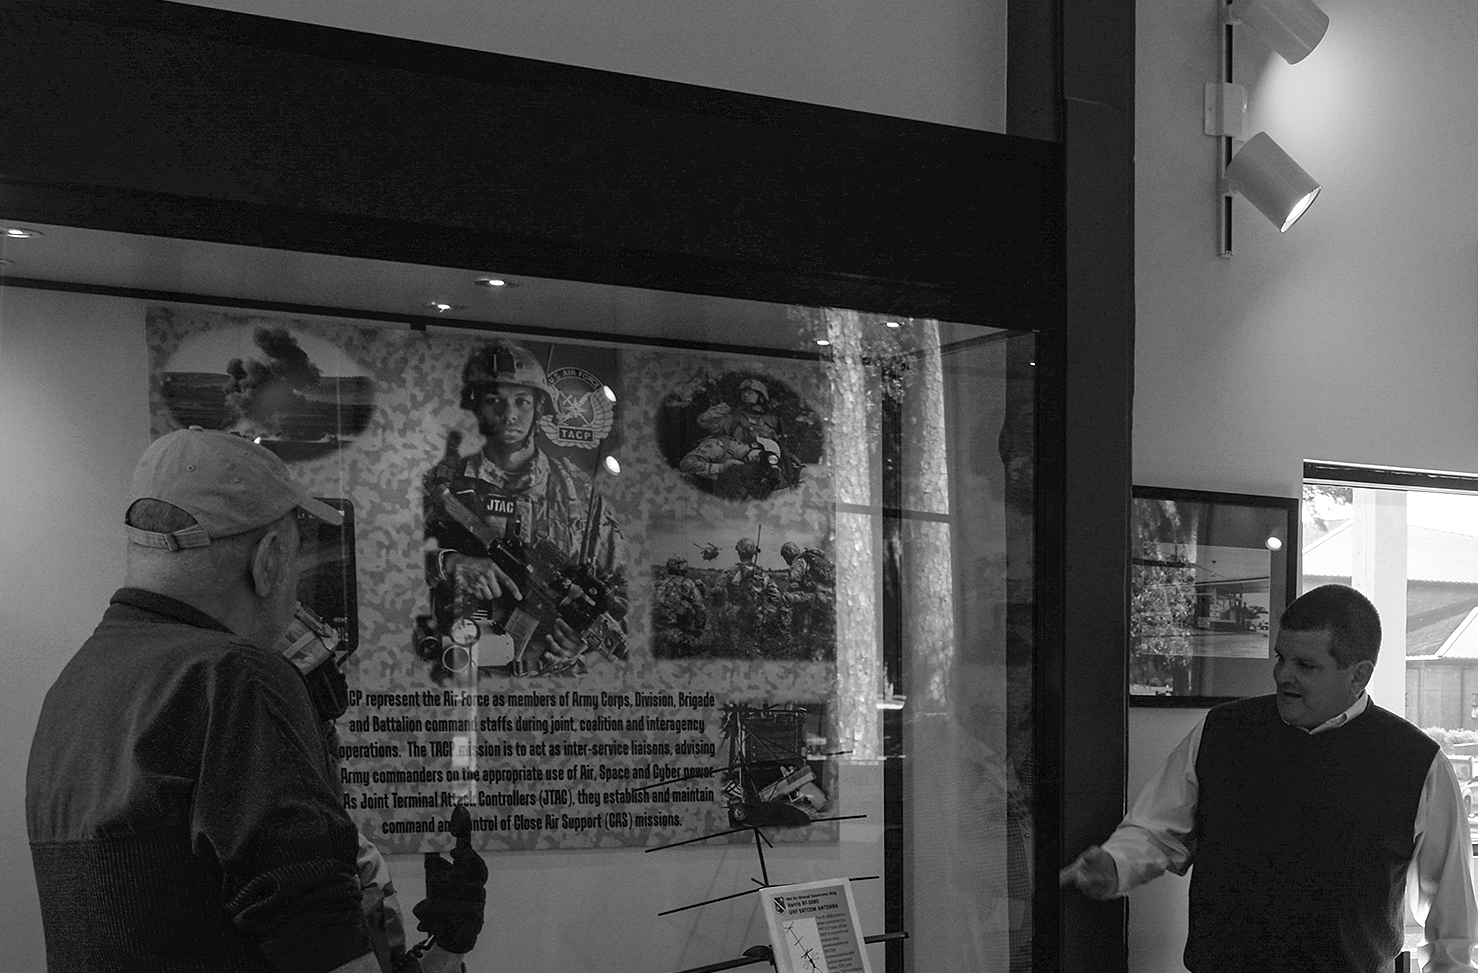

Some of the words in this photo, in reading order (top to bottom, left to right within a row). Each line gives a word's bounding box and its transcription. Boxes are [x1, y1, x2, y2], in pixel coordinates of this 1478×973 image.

[579, 371, 601, 389] FORCE
[561, 429, 591, 440] TACP
[487, 499, 514, 513] JTAC
[349, 691, 362, 707] CP
[366, 691, 420, 709] represent
[423, 691, 440, 707] the
[444, 691, 458, 706] Air
[461, 691, 489, 706] Force
[493, 694, 505, 707] as
[508, 691, 556, 707] members
[559, 691, 570, 707] of
[572, 691, 598, 709] Army
[601, 691, 633, 709] Corps,
[635, 692, 676, 708] Division,
[678, 692, 715, 709] Brigade
[350, 716, 369, 732] and
[373, 716, 422, 732] Battalion
[425, 716, 477, 732] command
[480, 716, 512, 732] staffs
[516, 716, 548, 734] during
[550, 716, 577, 734] joint,
[580, 716, 623, 731] coalition
[626, 716, 644, 731] and
[647, 716, 705, 733] interagency
[339, 742, 401, 760] operations.
[407, 742, 427, 757] The
[504, 741, 513, 756] is
[516, 741, 526, 756] to
[530, 741, 546, 756] act
[549, 744, 561, 756] as
[564, 740, 629, 756] inter-service
[631, 740, 673, 757] liaisons,
[675, 740, 715, 757] advising
[341, 768, 369, 786] Army
[373, 767, 443, 783] commanders
[446, 770, 459, 783] on
[463, 767, 480, 782] the
[483, 766, 543, 784] appropriate
[546, 768, 563, 781] use
[567, 765, 578, 780] of
[580, 765, 597, 781] Air,
[600, 764, 630, 782] Space
[632, 764, 650, 779] and
[653, 763, 681, 781] Cyber
[684, 766, 715, 780] power.
[343, 793, 357, 809] As
[361, 793, 389, 809] Joint
[392, 792, 437, 808] Terminal
[440, 791, 476, 807] Attack
[479, 790, 536, 806] Controllers
[539, 789, 575, 807] (JTAC),
[578, 789, 600, 806] they
[603, 788, 649, 804] establish
[652, 787, 670, 803] and
[672, 787, 714, 802] maintain
[382, 817, 434, 834] command
[438, 821, 451, 833] an
[473, 816, 497, 832] ntrol
[501, 815, 511, 830] of
[514, 815, 542, 830] Close
[545, 814, 559, 829] Air
[562, 813, 602, 831] Support
[605, 812, 633, 830] (CAS)
[635, 812, 682, 827] missions.
